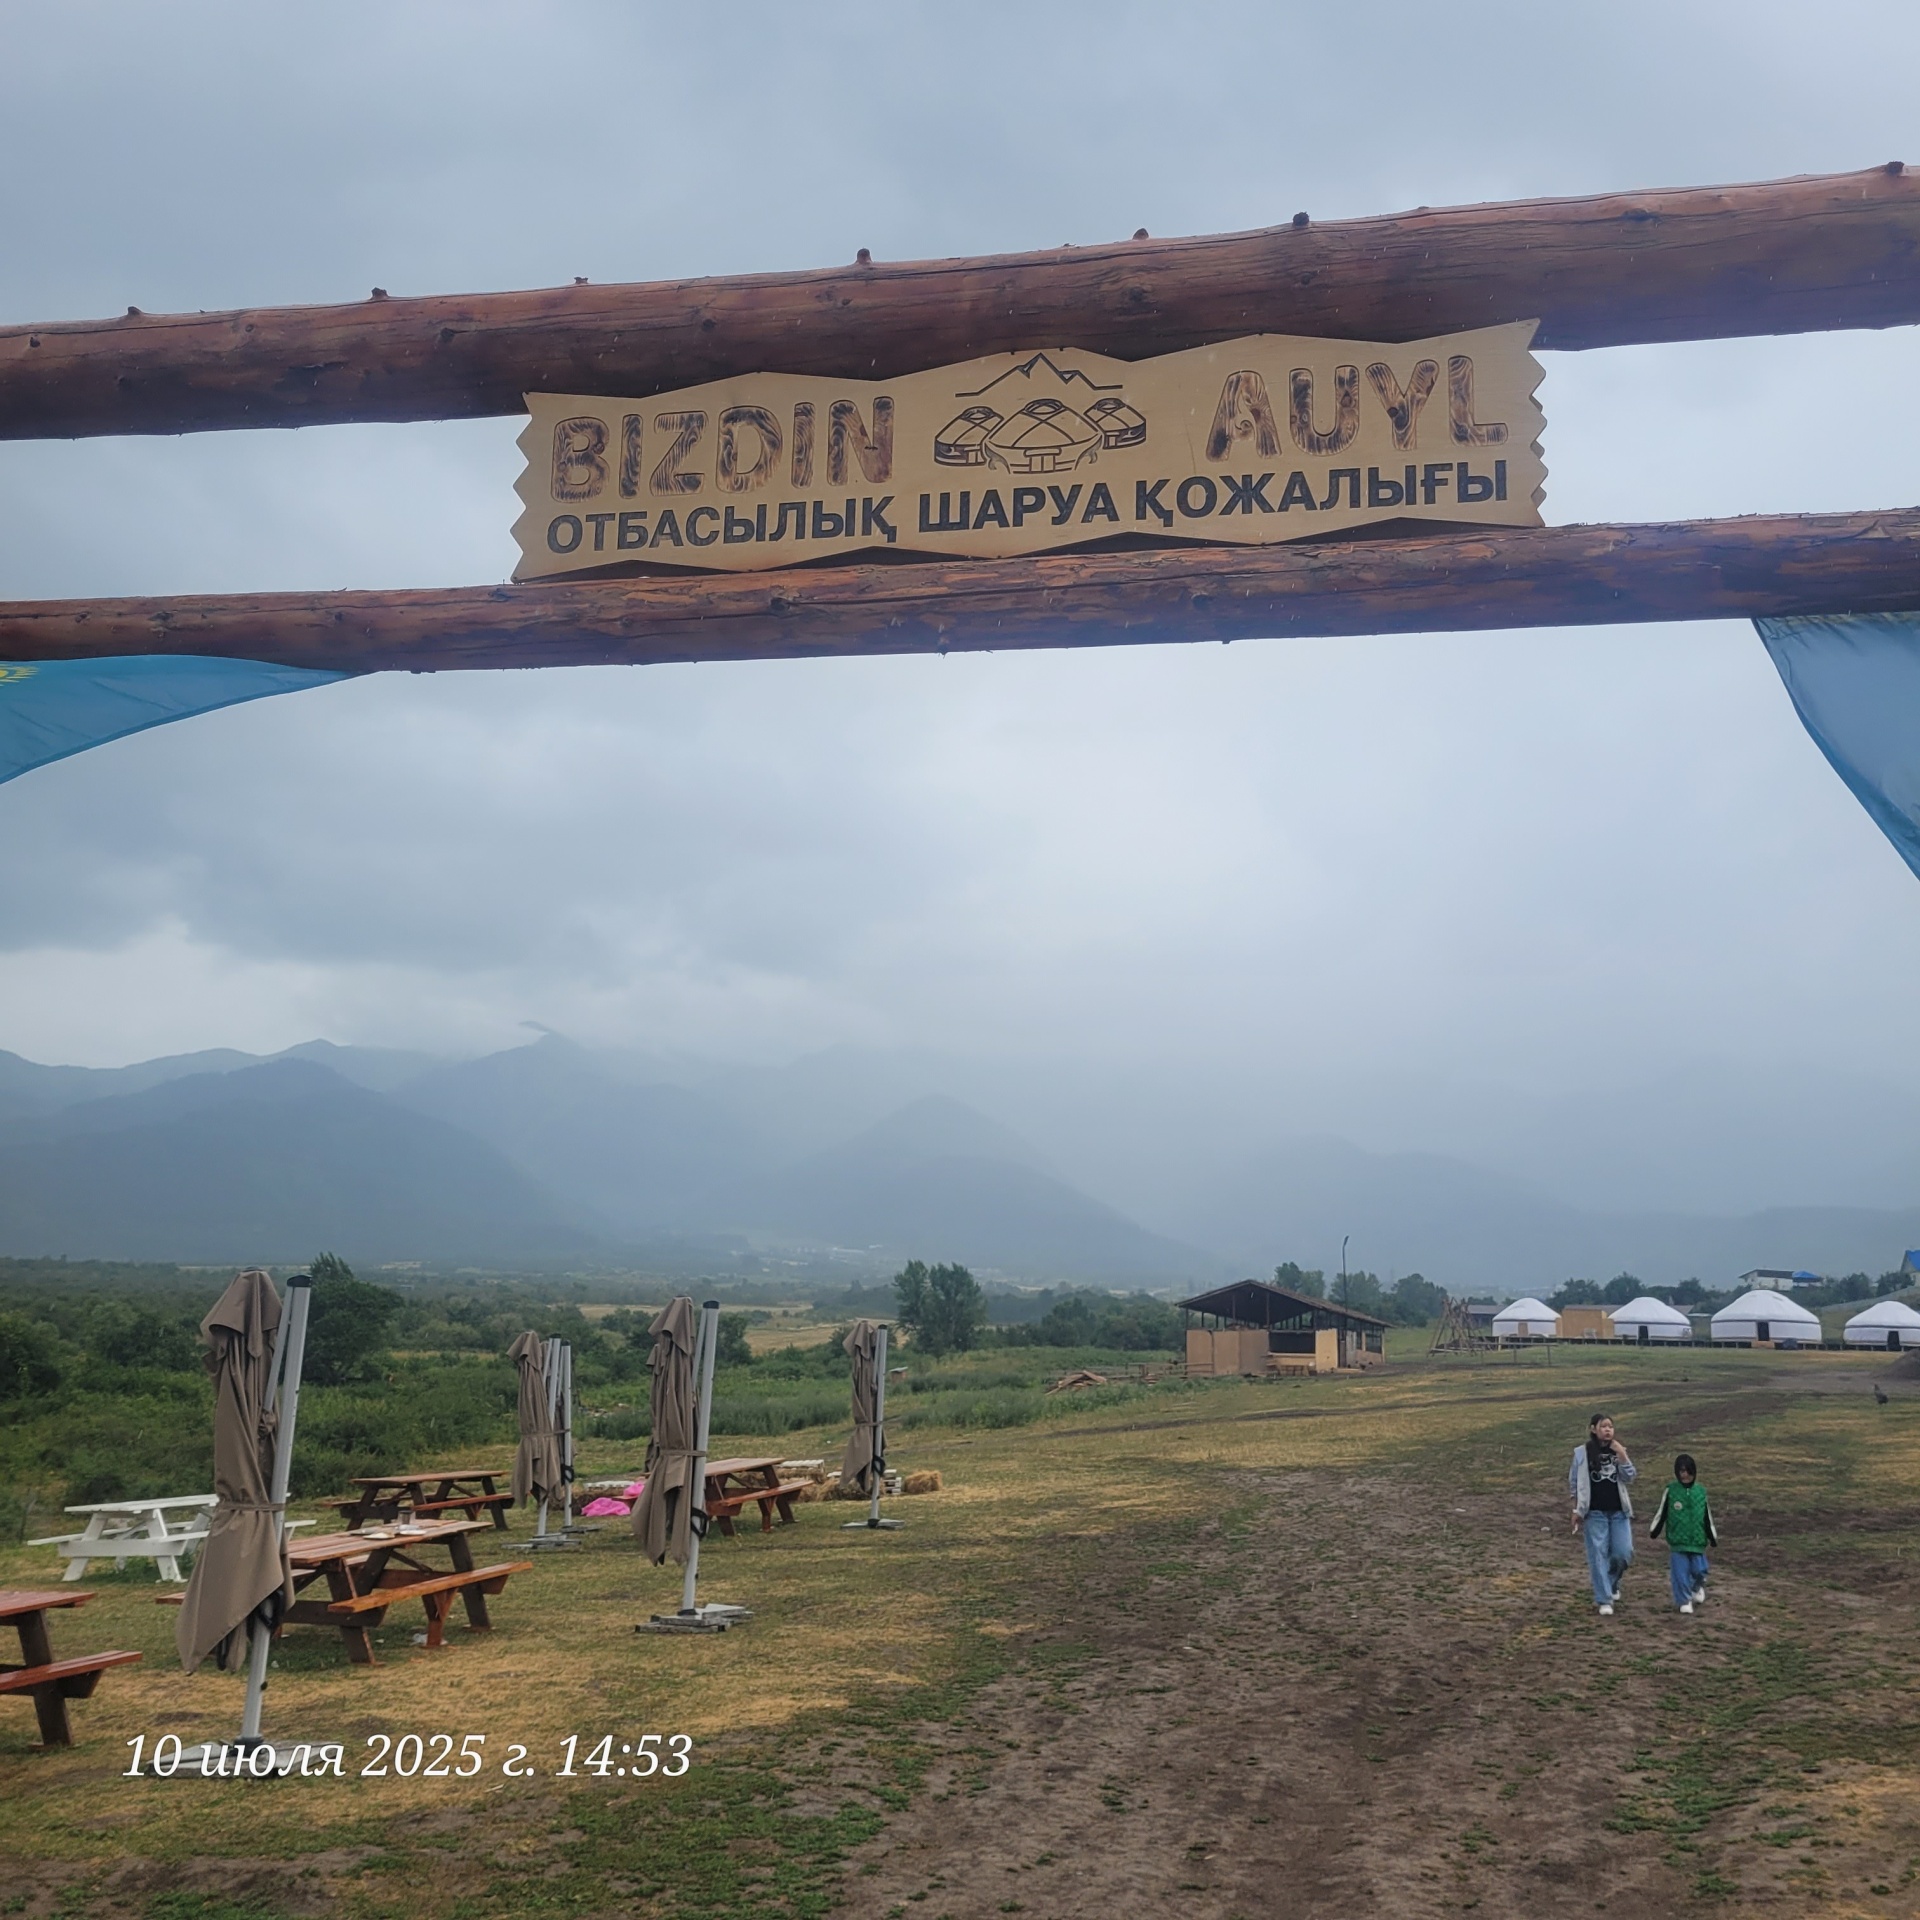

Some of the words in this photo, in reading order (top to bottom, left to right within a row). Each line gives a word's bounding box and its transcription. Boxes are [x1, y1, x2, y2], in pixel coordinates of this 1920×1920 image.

[551, 396, 894, 504] BIZDIN
[1206, 355, 1509, 462] AUYL
[547, 495, 898, 554] ОТБАСЫЛЫҚ
[918, 481, 1121, 533] ШАРУА
[1135, 460, 1509, 528] ҚОЖАЛЫҒЫ
